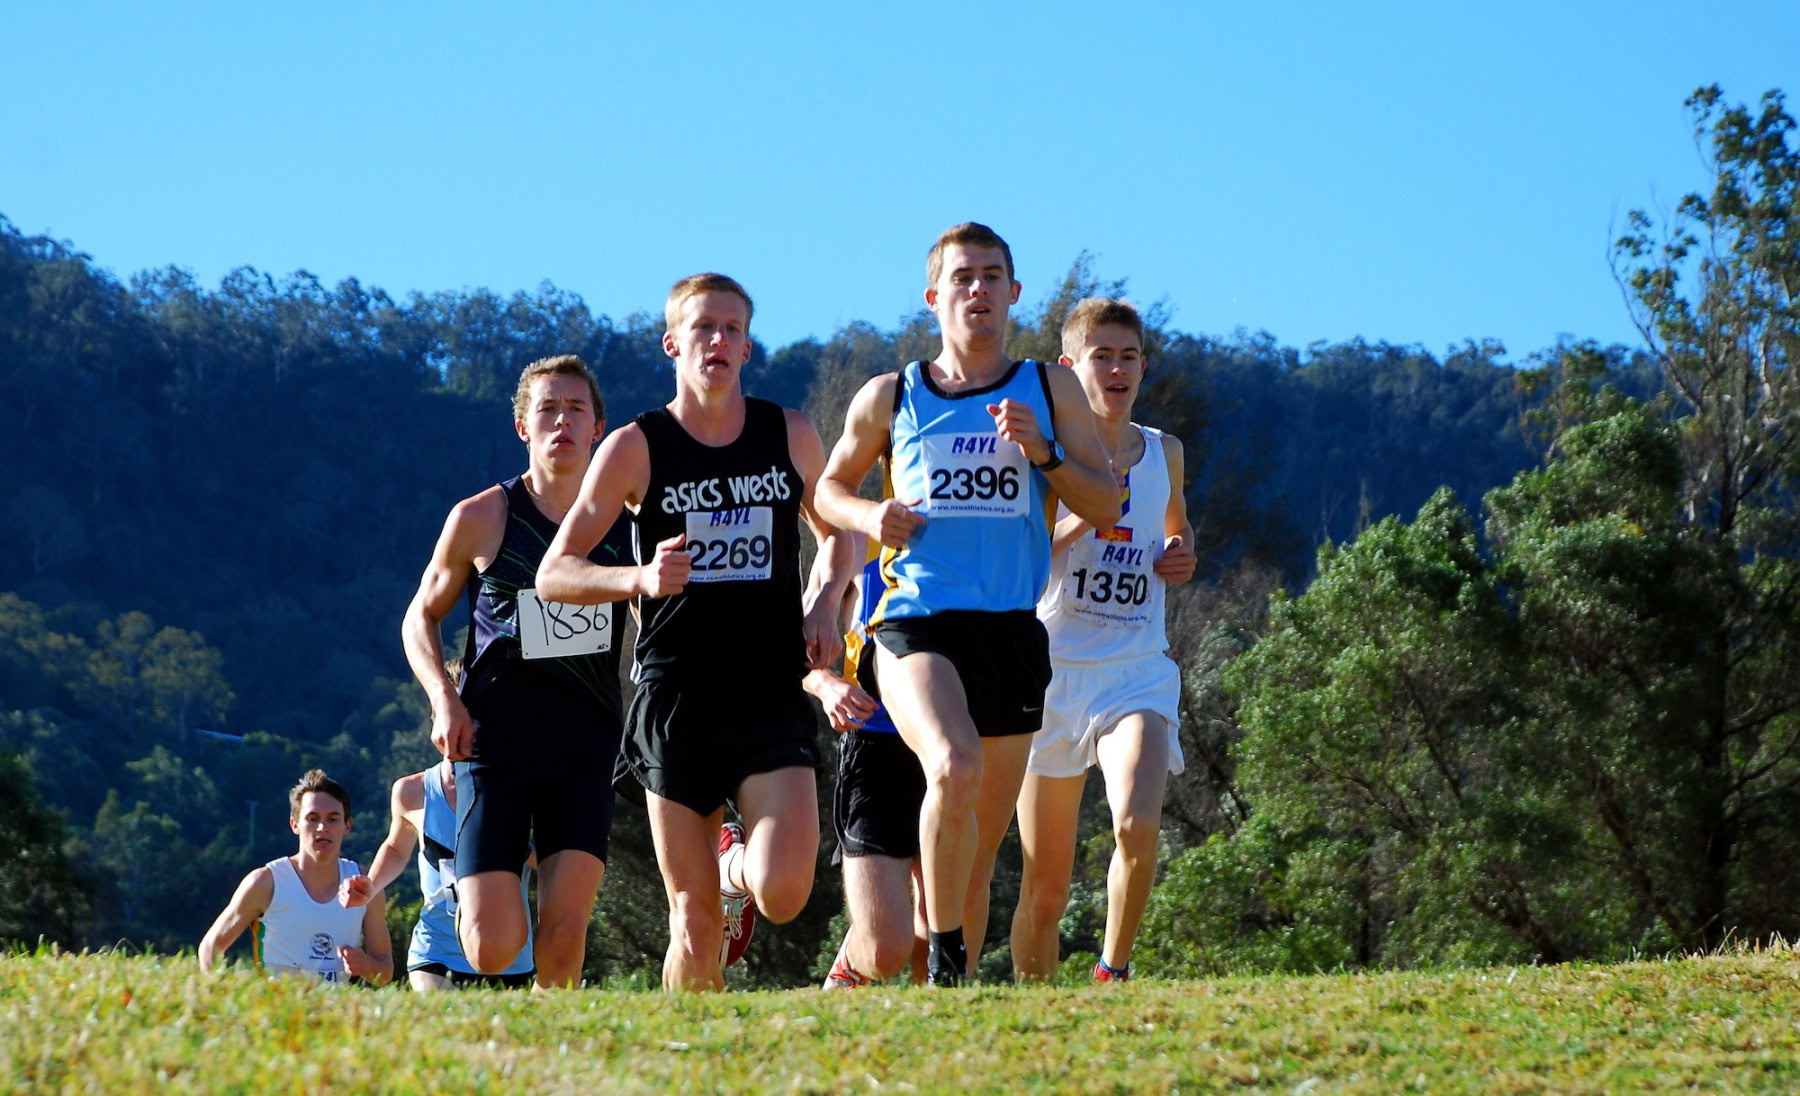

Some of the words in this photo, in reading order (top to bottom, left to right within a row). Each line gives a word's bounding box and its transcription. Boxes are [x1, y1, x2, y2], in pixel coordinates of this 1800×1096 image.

[952, 437, 998, 454] R4YL
[661, 478, 723, 514] asics
[728, 465, 790, 504] wests
[930, 466, 1019, 501] 2396
[709, 507, 752, 527] R4YL
[686, 535, 771, 571] 2269
[1102, 544, 1144, 566] R4YL
[1072, 568, 1148, 605] 1350
[534, 595, 609, 646] 1836
